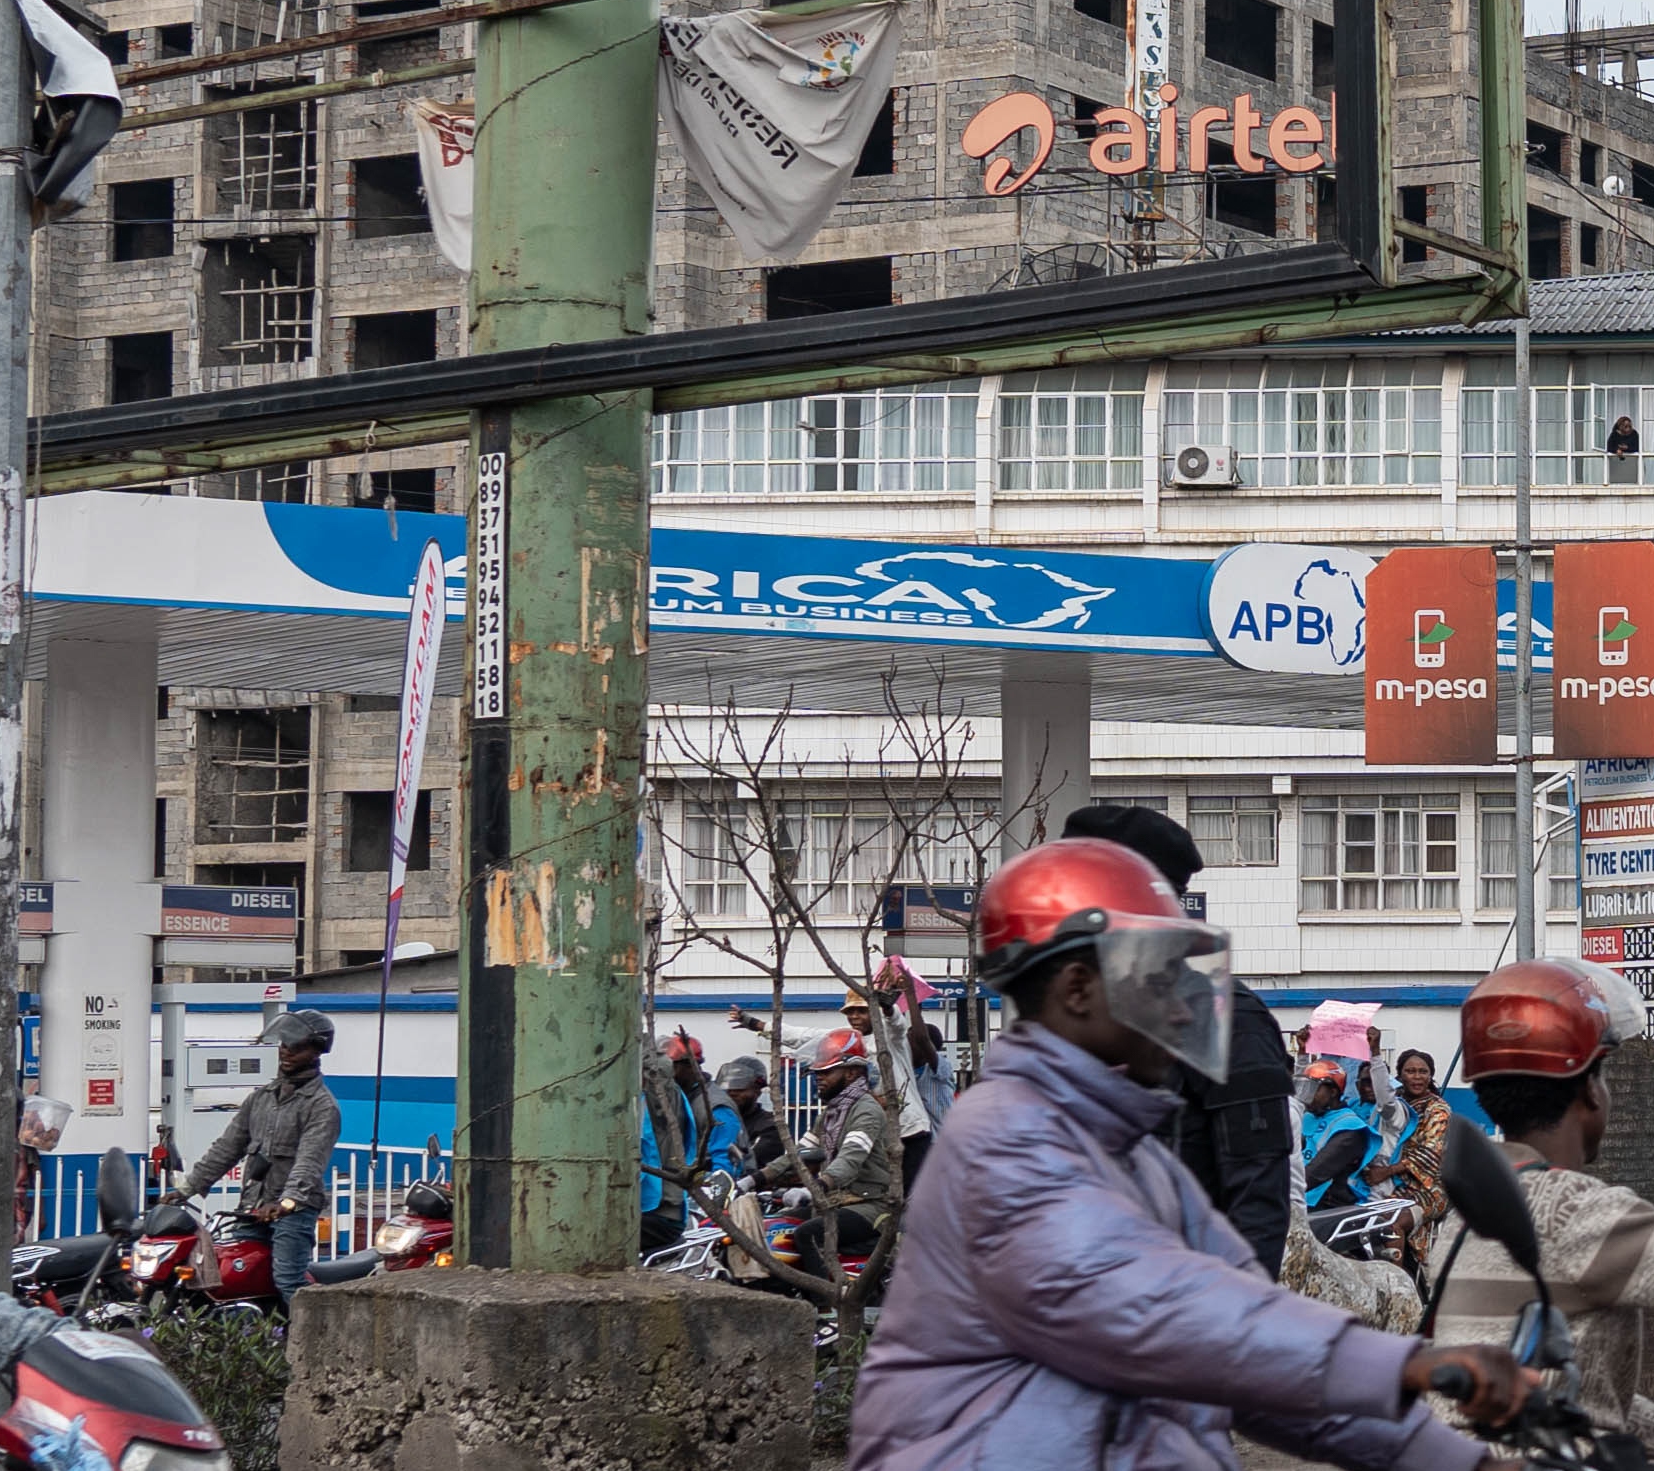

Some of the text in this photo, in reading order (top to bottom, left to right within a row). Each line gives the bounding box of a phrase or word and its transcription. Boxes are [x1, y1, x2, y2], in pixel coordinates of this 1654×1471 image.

[1089, 83, 1336, 174] airte
[741, 603, 973, 625] BUSINESS
[1229, 600, 1326, 645] APB
[1376, 677, 1487, 707] m-pesa
[1586, 851, 1617, 876] TYRE
[232, 893, 292, 909] DIESEL
[165, 915, 230, 932] ESSENCE
[1582, 936, 1618, 956] DIESEL
[85, 996, 104, 1013] NO
[84, 1019, 121, 1030] SMOKING
